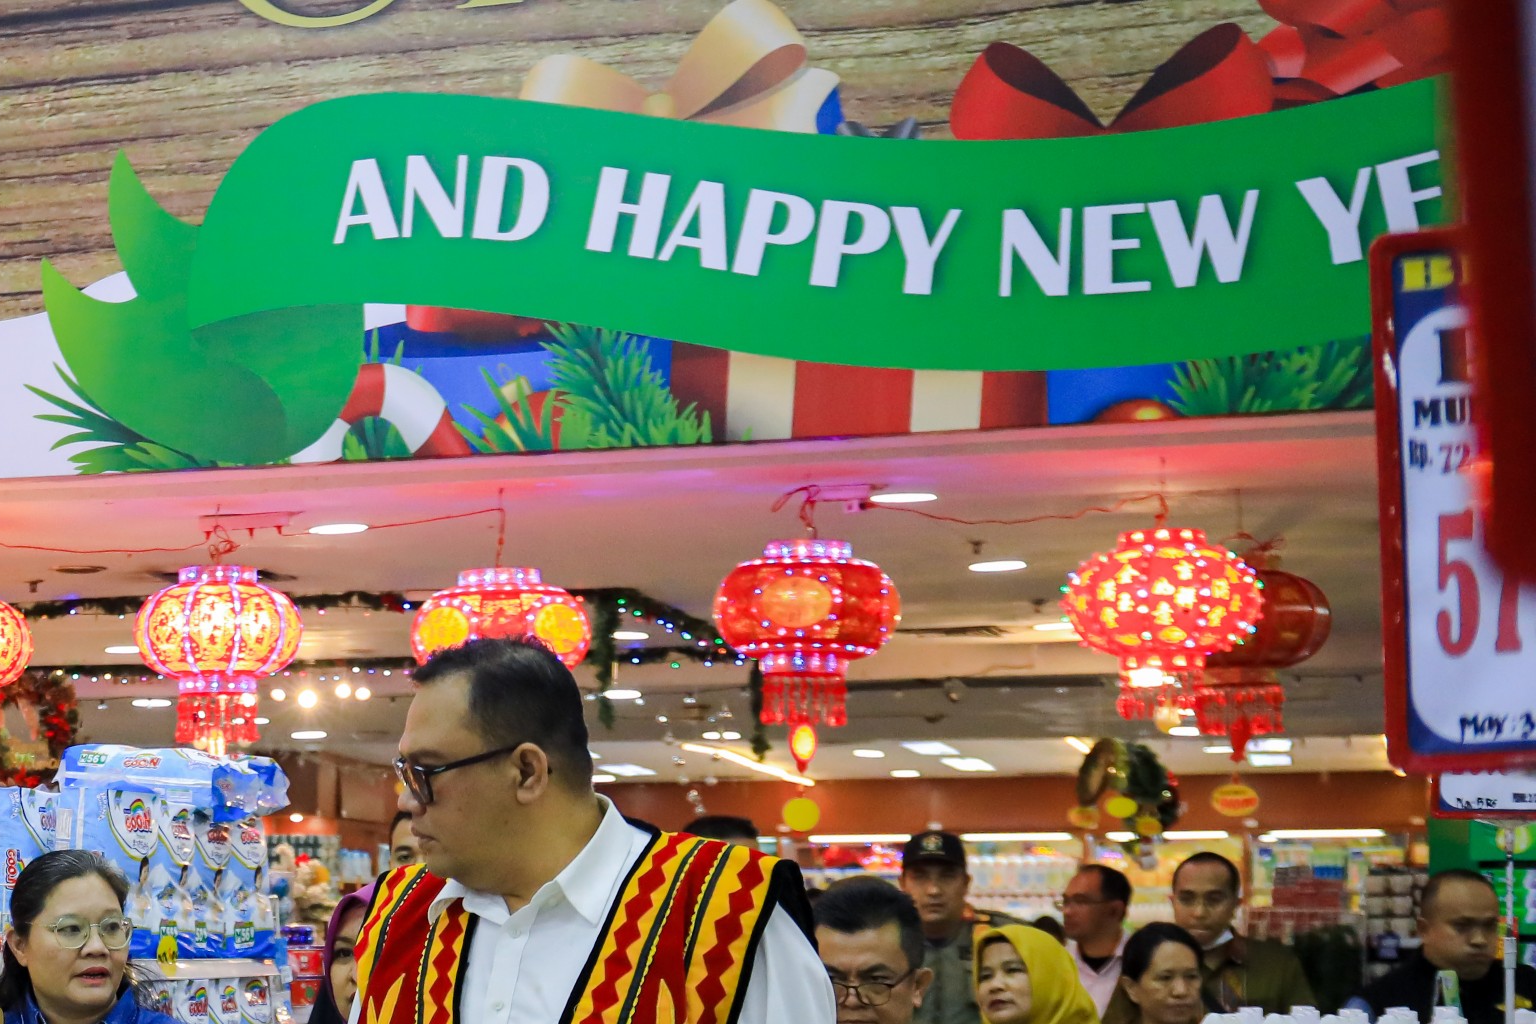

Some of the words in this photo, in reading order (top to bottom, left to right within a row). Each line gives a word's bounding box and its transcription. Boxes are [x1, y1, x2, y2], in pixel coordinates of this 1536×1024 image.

[333, 154, 548, 244] AND
[584, 167, 963, 295] HAPPY
[999, 189, 1258, 298] NEW
